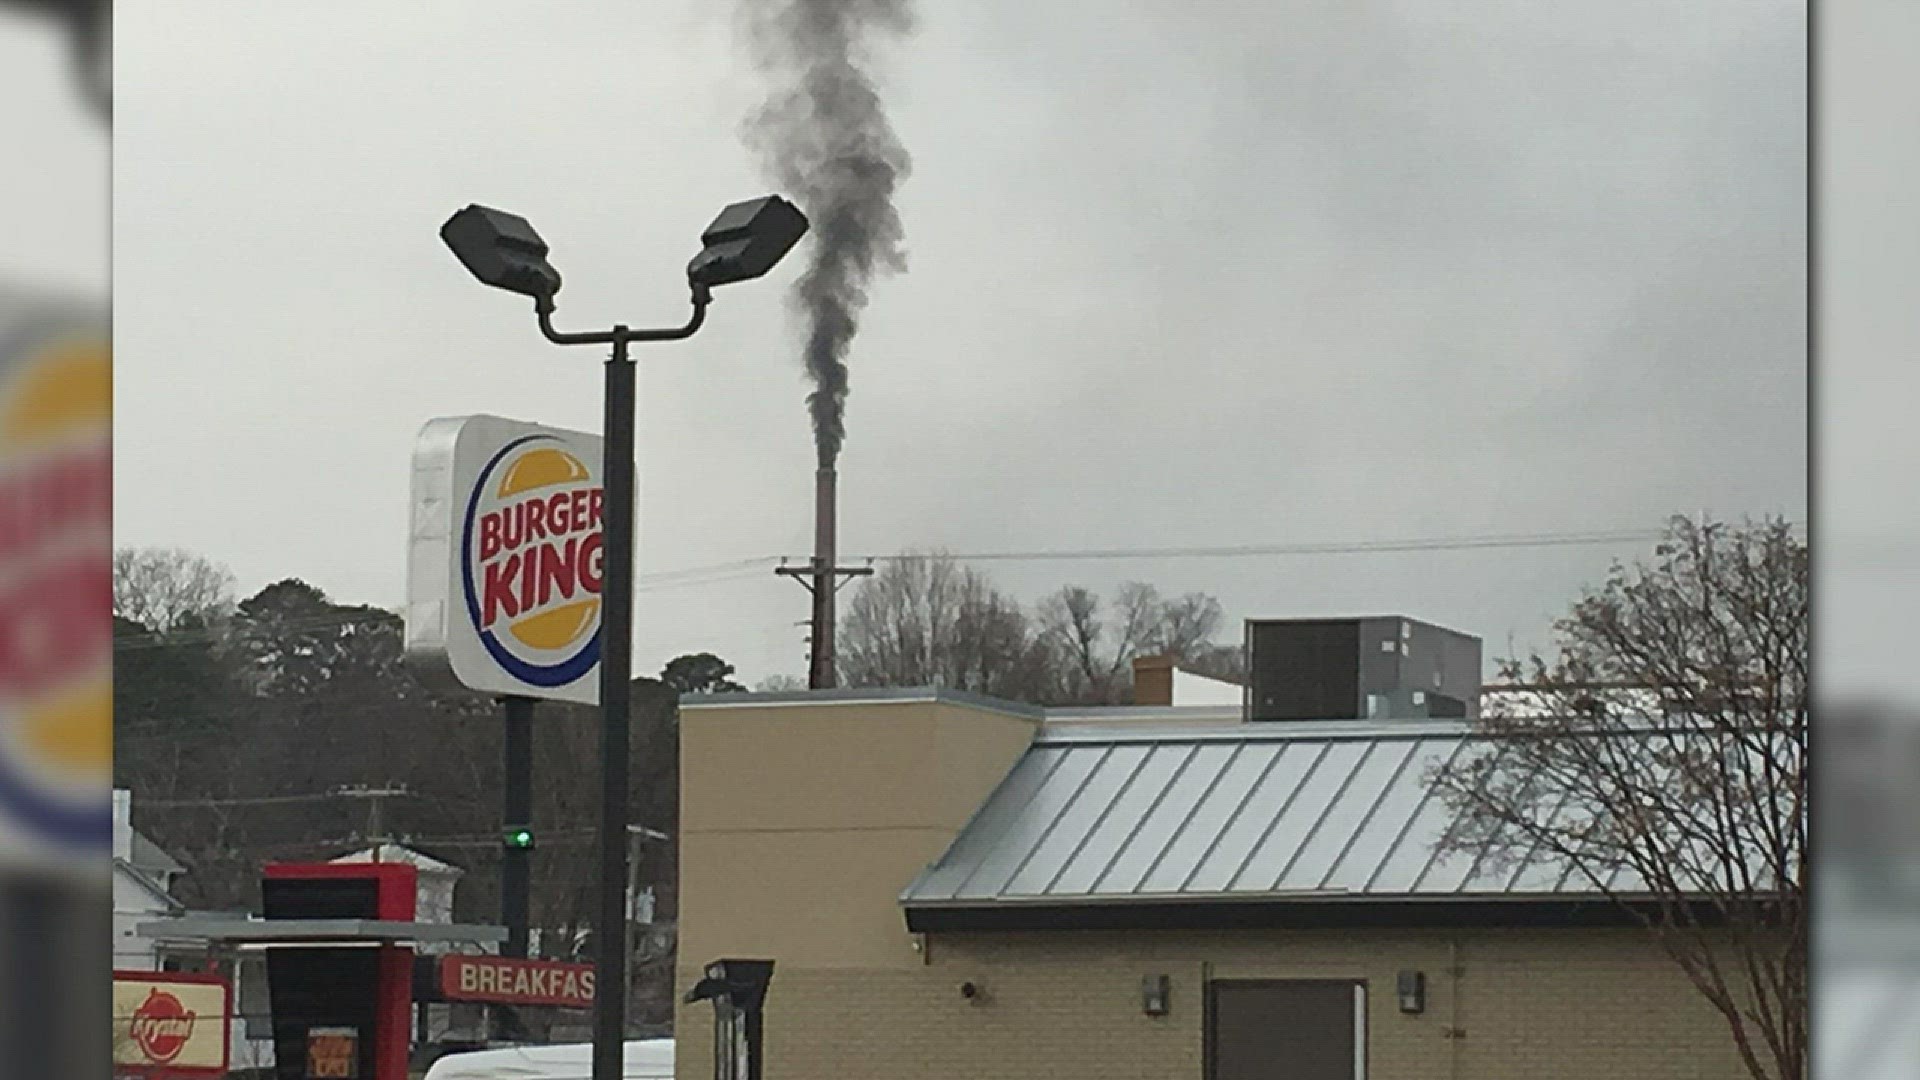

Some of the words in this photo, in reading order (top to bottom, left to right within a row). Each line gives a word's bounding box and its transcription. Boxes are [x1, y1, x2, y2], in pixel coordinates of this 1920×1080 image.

[479, 488, 605, 562] BURGER
[482, 532, 605, 628] KING
[460, 963, 596, 999] BREAKFAS
